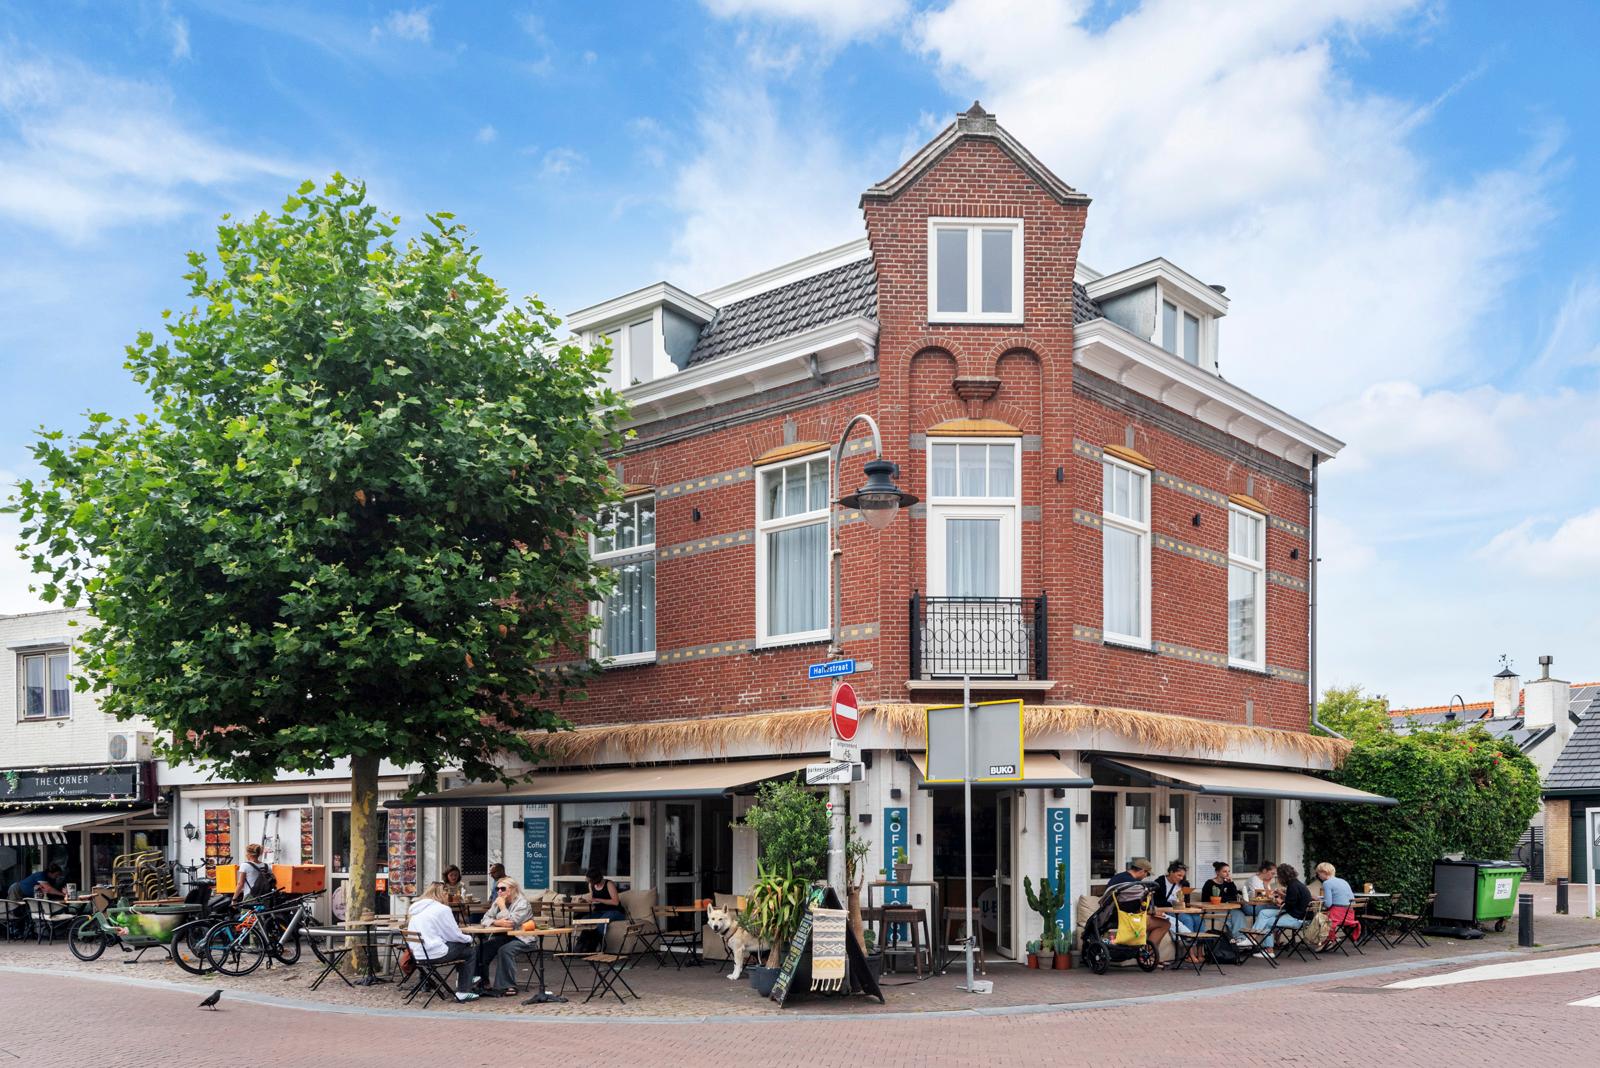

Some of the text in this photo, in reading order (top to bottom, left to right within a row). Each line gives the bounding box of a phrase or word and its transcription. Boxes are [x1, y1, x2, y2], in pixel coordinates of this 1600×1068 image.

[990, 765, 1014, 775] BUKO
[35, 775, 89, 786] THE CORNER
[527, 841, 547, 849] Coffee
